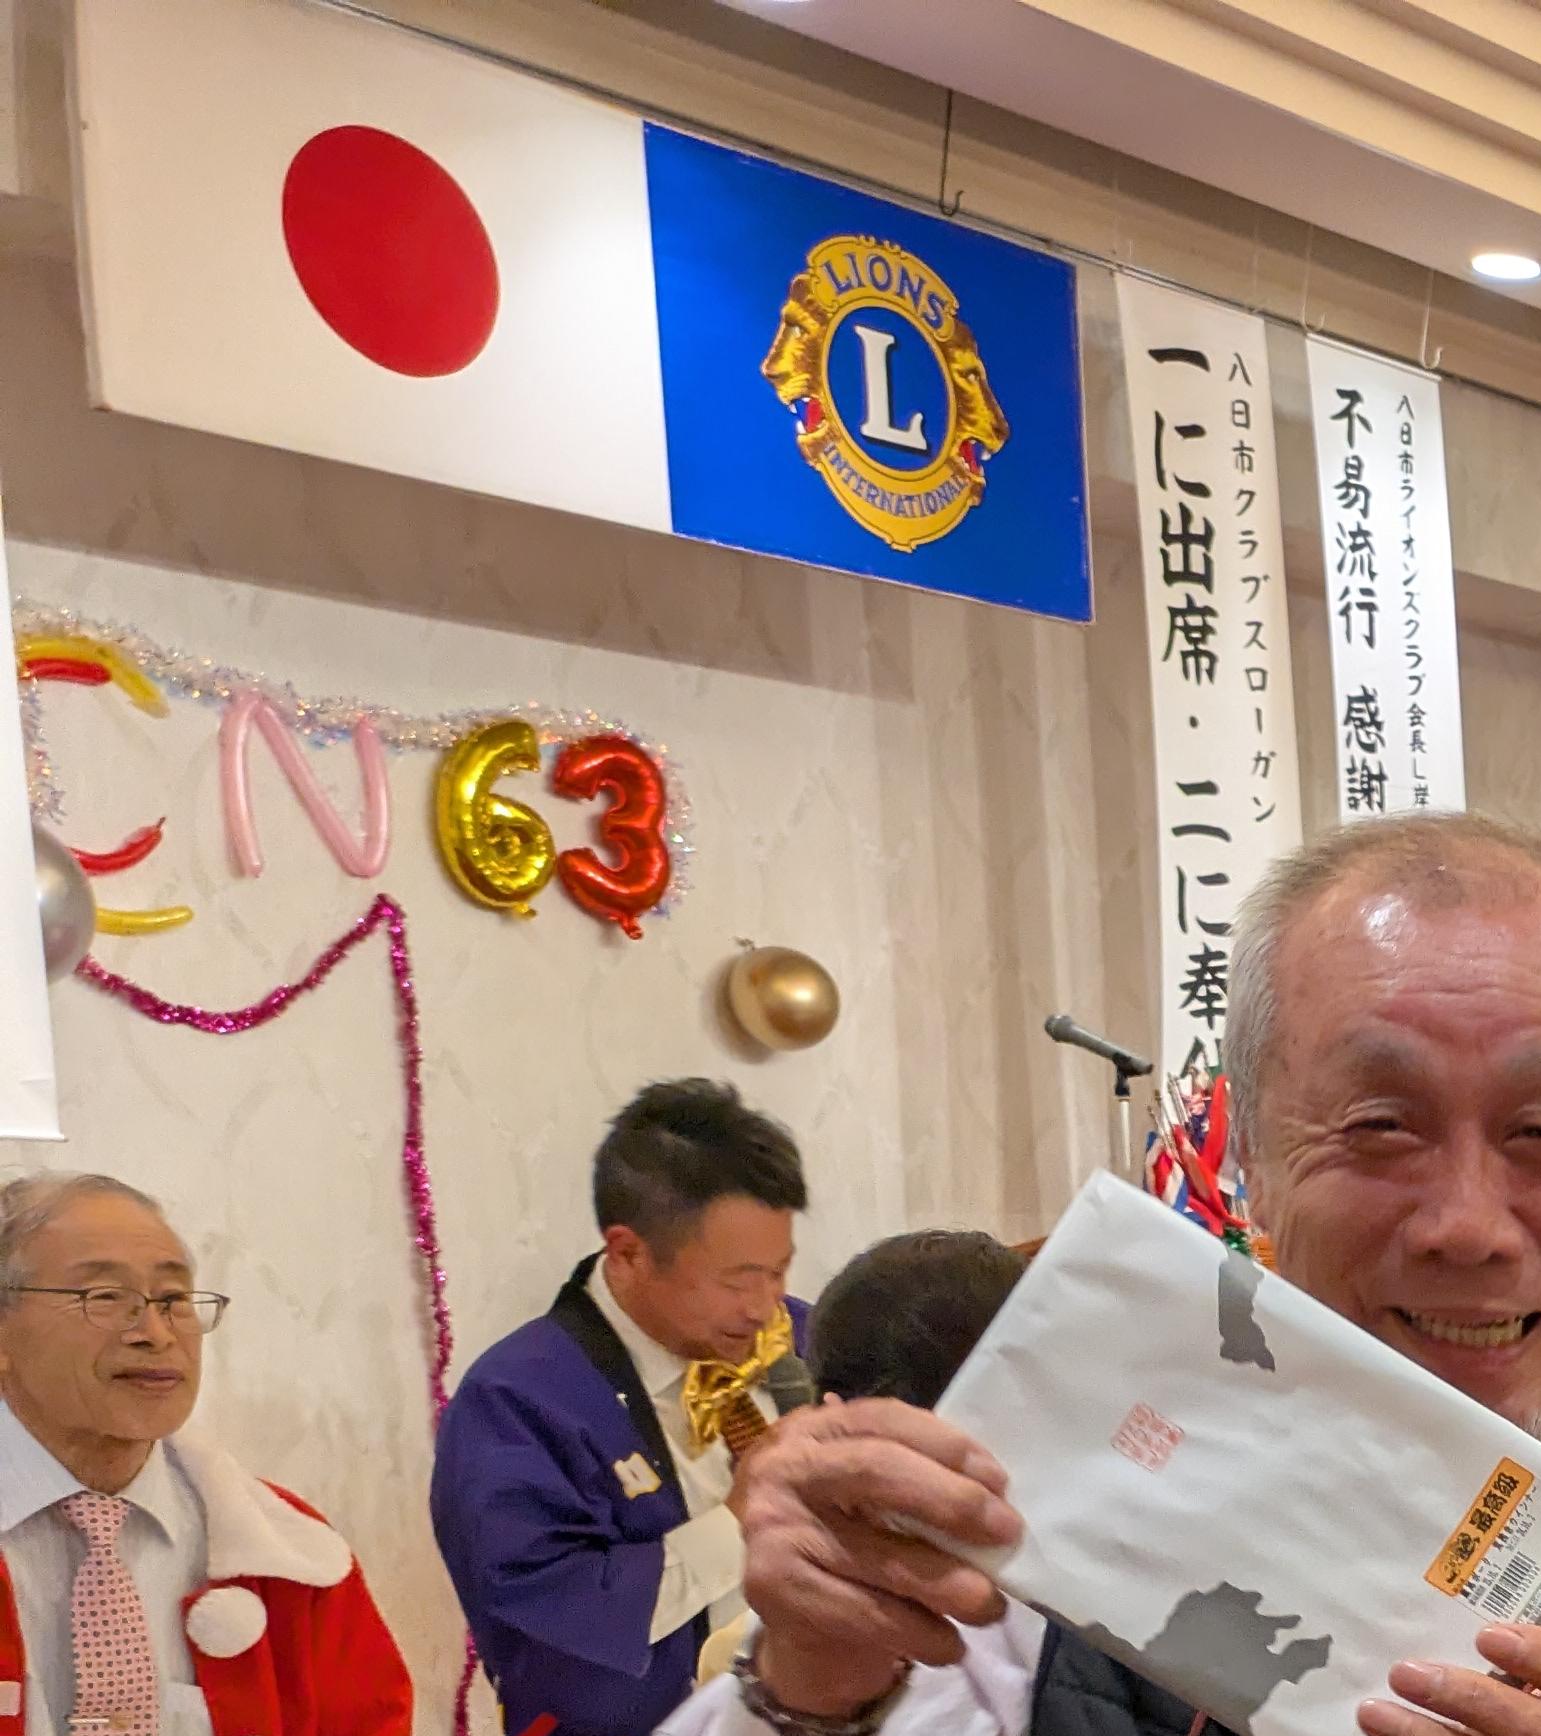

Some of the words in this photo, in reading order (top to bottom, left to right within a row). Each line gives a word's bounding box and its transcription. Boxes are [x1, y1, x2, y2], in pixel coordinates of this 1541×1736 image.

[825, 251, 948, 330] LIONS
[855, 325, 928, 451] L
[823, 443, 971, 519] INTERNATIONAL
[1328, 388, 1382, 649] 不易流行
[1228, 351, 1278, 825] 八日市クラブスローガン
[1343, 685, 1389, 812] 感謝
[434, 720, 670, 940] 63
[1469, 1472, 1520, 1534] 最高級
